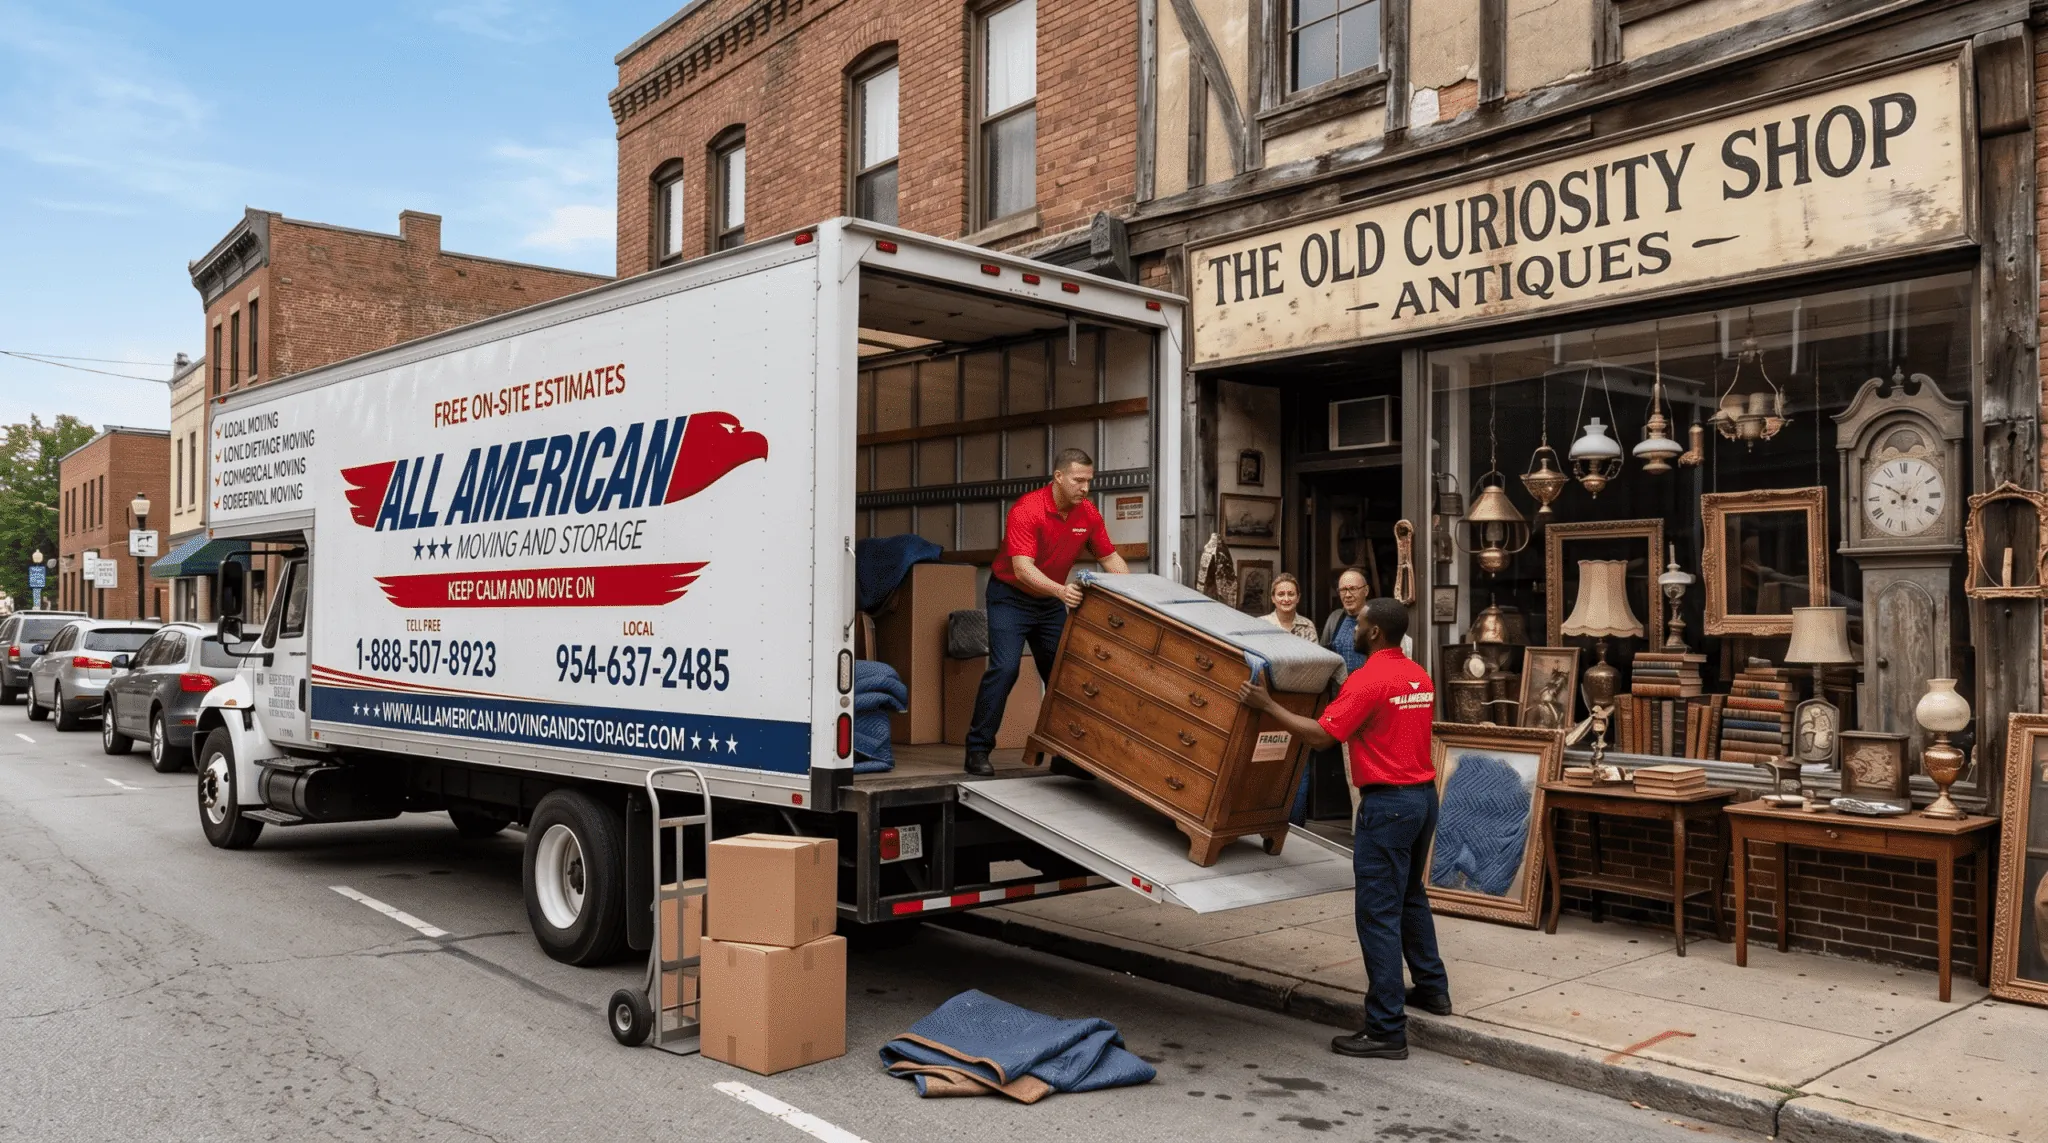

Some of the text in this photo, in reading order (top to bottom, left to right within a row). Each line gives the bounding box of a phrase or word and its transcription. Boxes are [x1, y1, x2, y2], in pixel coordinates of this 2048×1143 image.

[1208, 92, 1917, 306] THE OLD CURIOSITY SHOP
[1391, 231, 1672, 320] ANTIQUES
[435, 363, 626, 428] FREE ON-SITE ESTIMATES
[282, 429, 315, 452] MOVING
[270, 482, 303, 504] MOVING
[374, 415, 688, 532] ALL AMERICAN
[456, 520, 647, 560] MOVING AND STORAGE
[448, 576, 595, 600] KEEP CALM AND MOVE ON
[423, 619, 441, 632] FREE
[623, 621, 655, 636] LOCAL
[356, 637, 497, 678] 1-888-507-8923
[556, 644, 730, 692] 954-637-2485
[1259, 735, 1289, 744] FRAGILE
